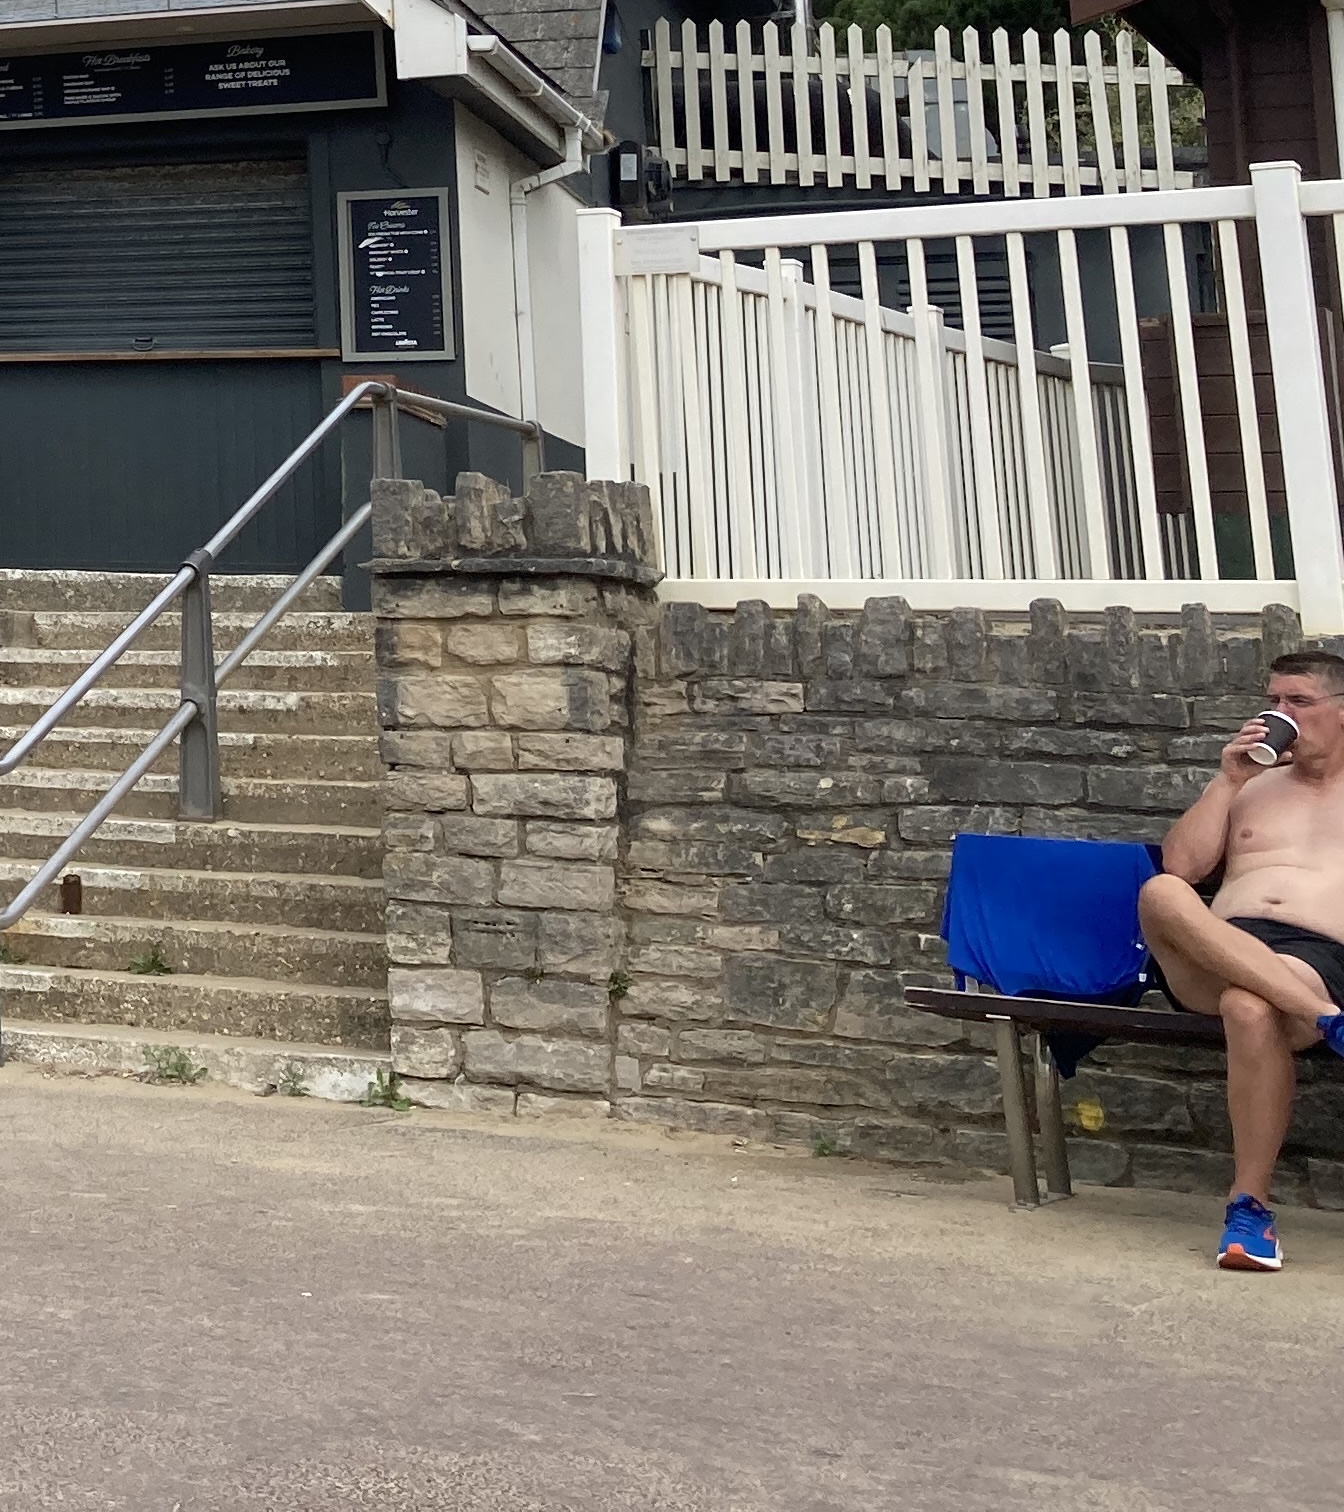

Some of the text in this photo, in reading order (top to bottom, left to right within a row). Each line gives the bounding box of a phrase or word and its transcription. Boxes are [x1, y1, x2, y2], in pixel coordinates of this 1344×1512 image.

[225, 45, 265, 58] Bakery
[238, 61, 267, 69] ABOUT
[268, 59, 286, 67] OUR
[247, 68, 291, 78] DELICIOUS
[217, 79, 278, 90] SWEET TREATS
